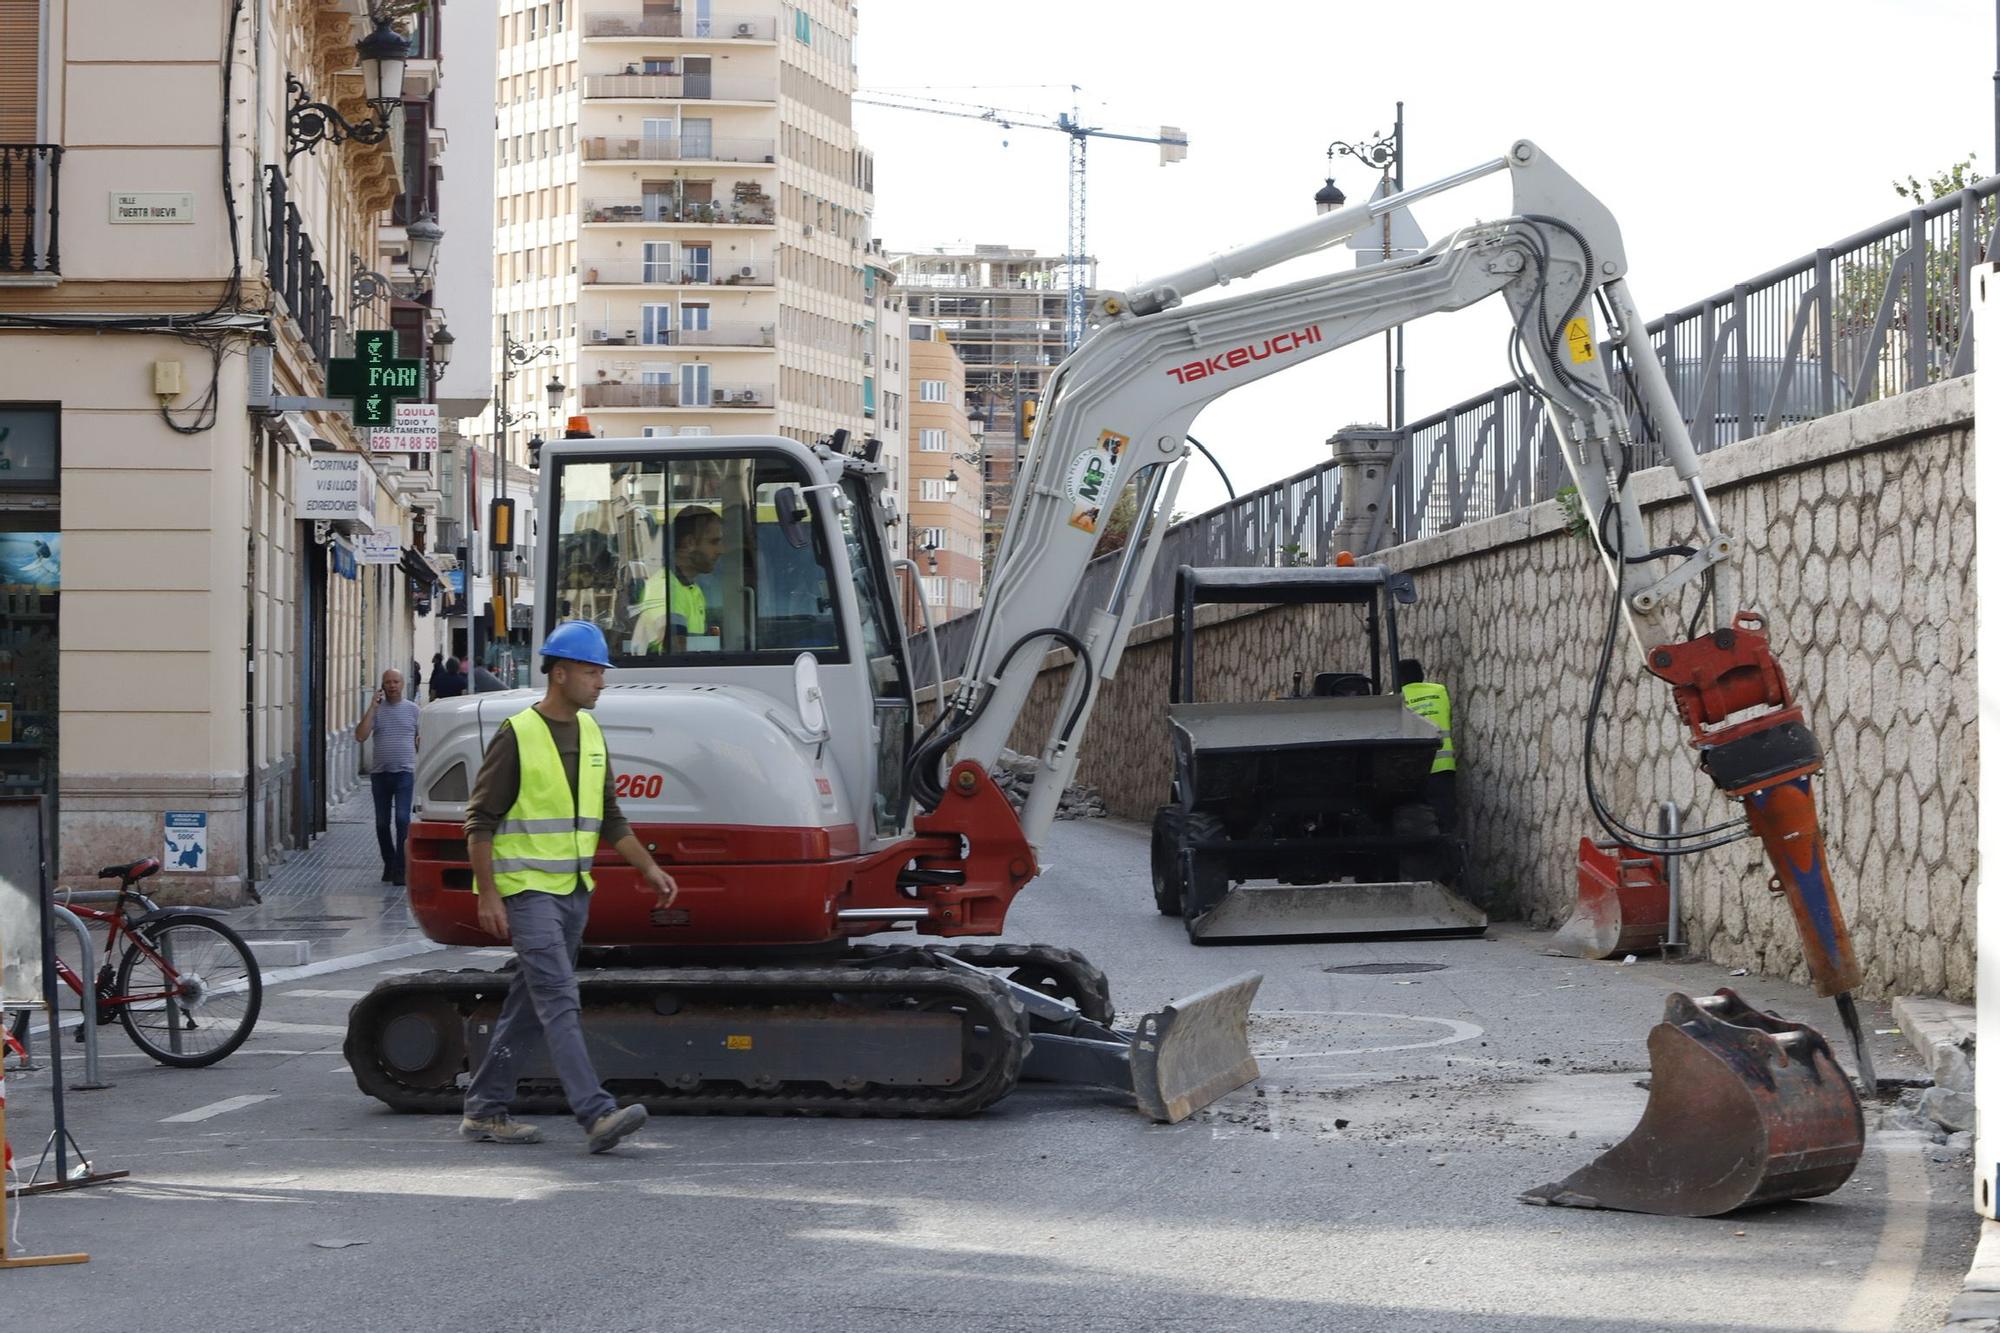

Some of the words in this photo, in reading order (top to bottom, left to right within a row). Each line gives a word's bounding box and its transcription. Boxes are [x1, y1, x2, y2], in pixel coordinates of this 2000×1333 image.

[119, 207, 148, 217] PUERTA
[150, 207, 176, 217] NUEVA
[397, 408, 436, 417] LQUILA
[372, 436, 391, 450] 626
[394, 436, 406, 449] 74
[410, 436, 422, 449] 88
[425, 436, 438, 449] 56
[317, 480, 358, 491] VISILLOS
[306, 500, 358, 511] EDREDONES
[615, 774, 664, 798] 260
